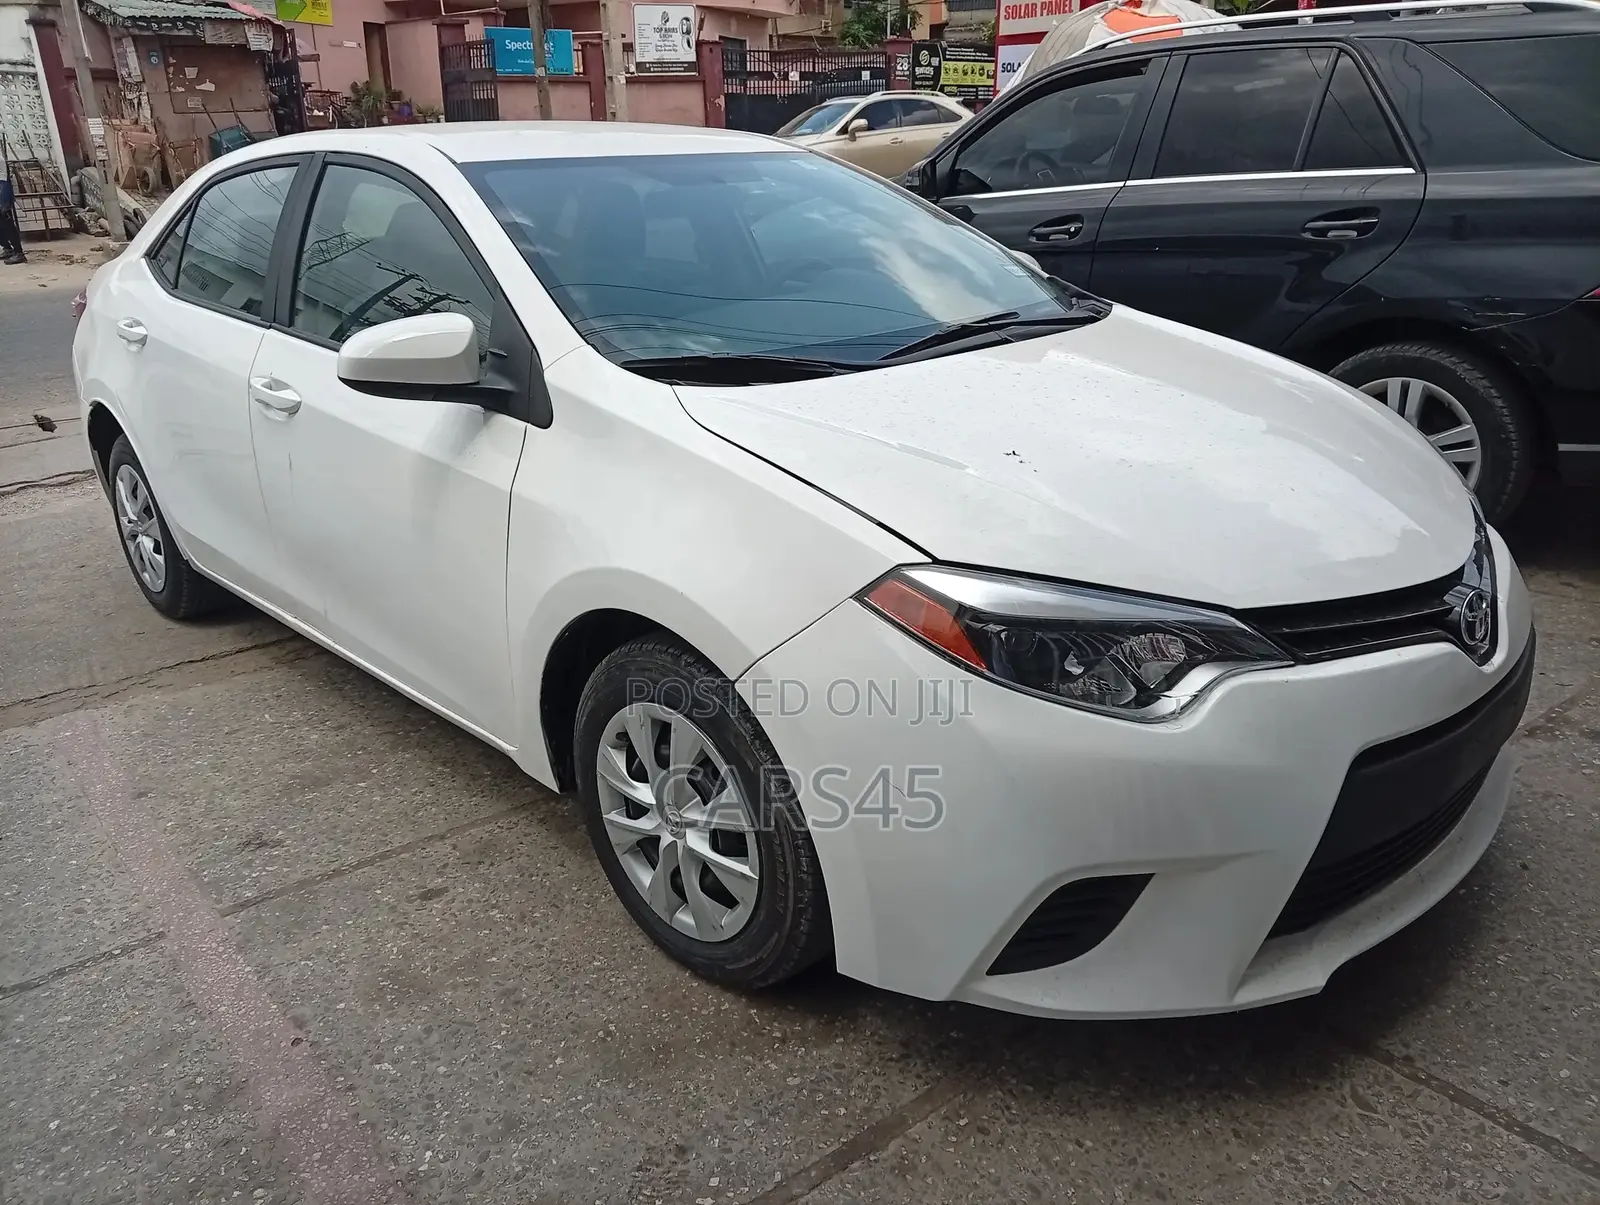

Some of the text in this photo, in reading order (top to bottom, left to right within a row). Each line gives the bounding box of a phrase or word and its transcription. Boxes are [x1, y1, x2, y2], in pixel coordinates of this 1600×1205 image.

[1004, 0, 1073, 20] SOLAR PANEL
[896, 57, 909, 70] 28
[1001, 62, 1023, 73] SOLA
